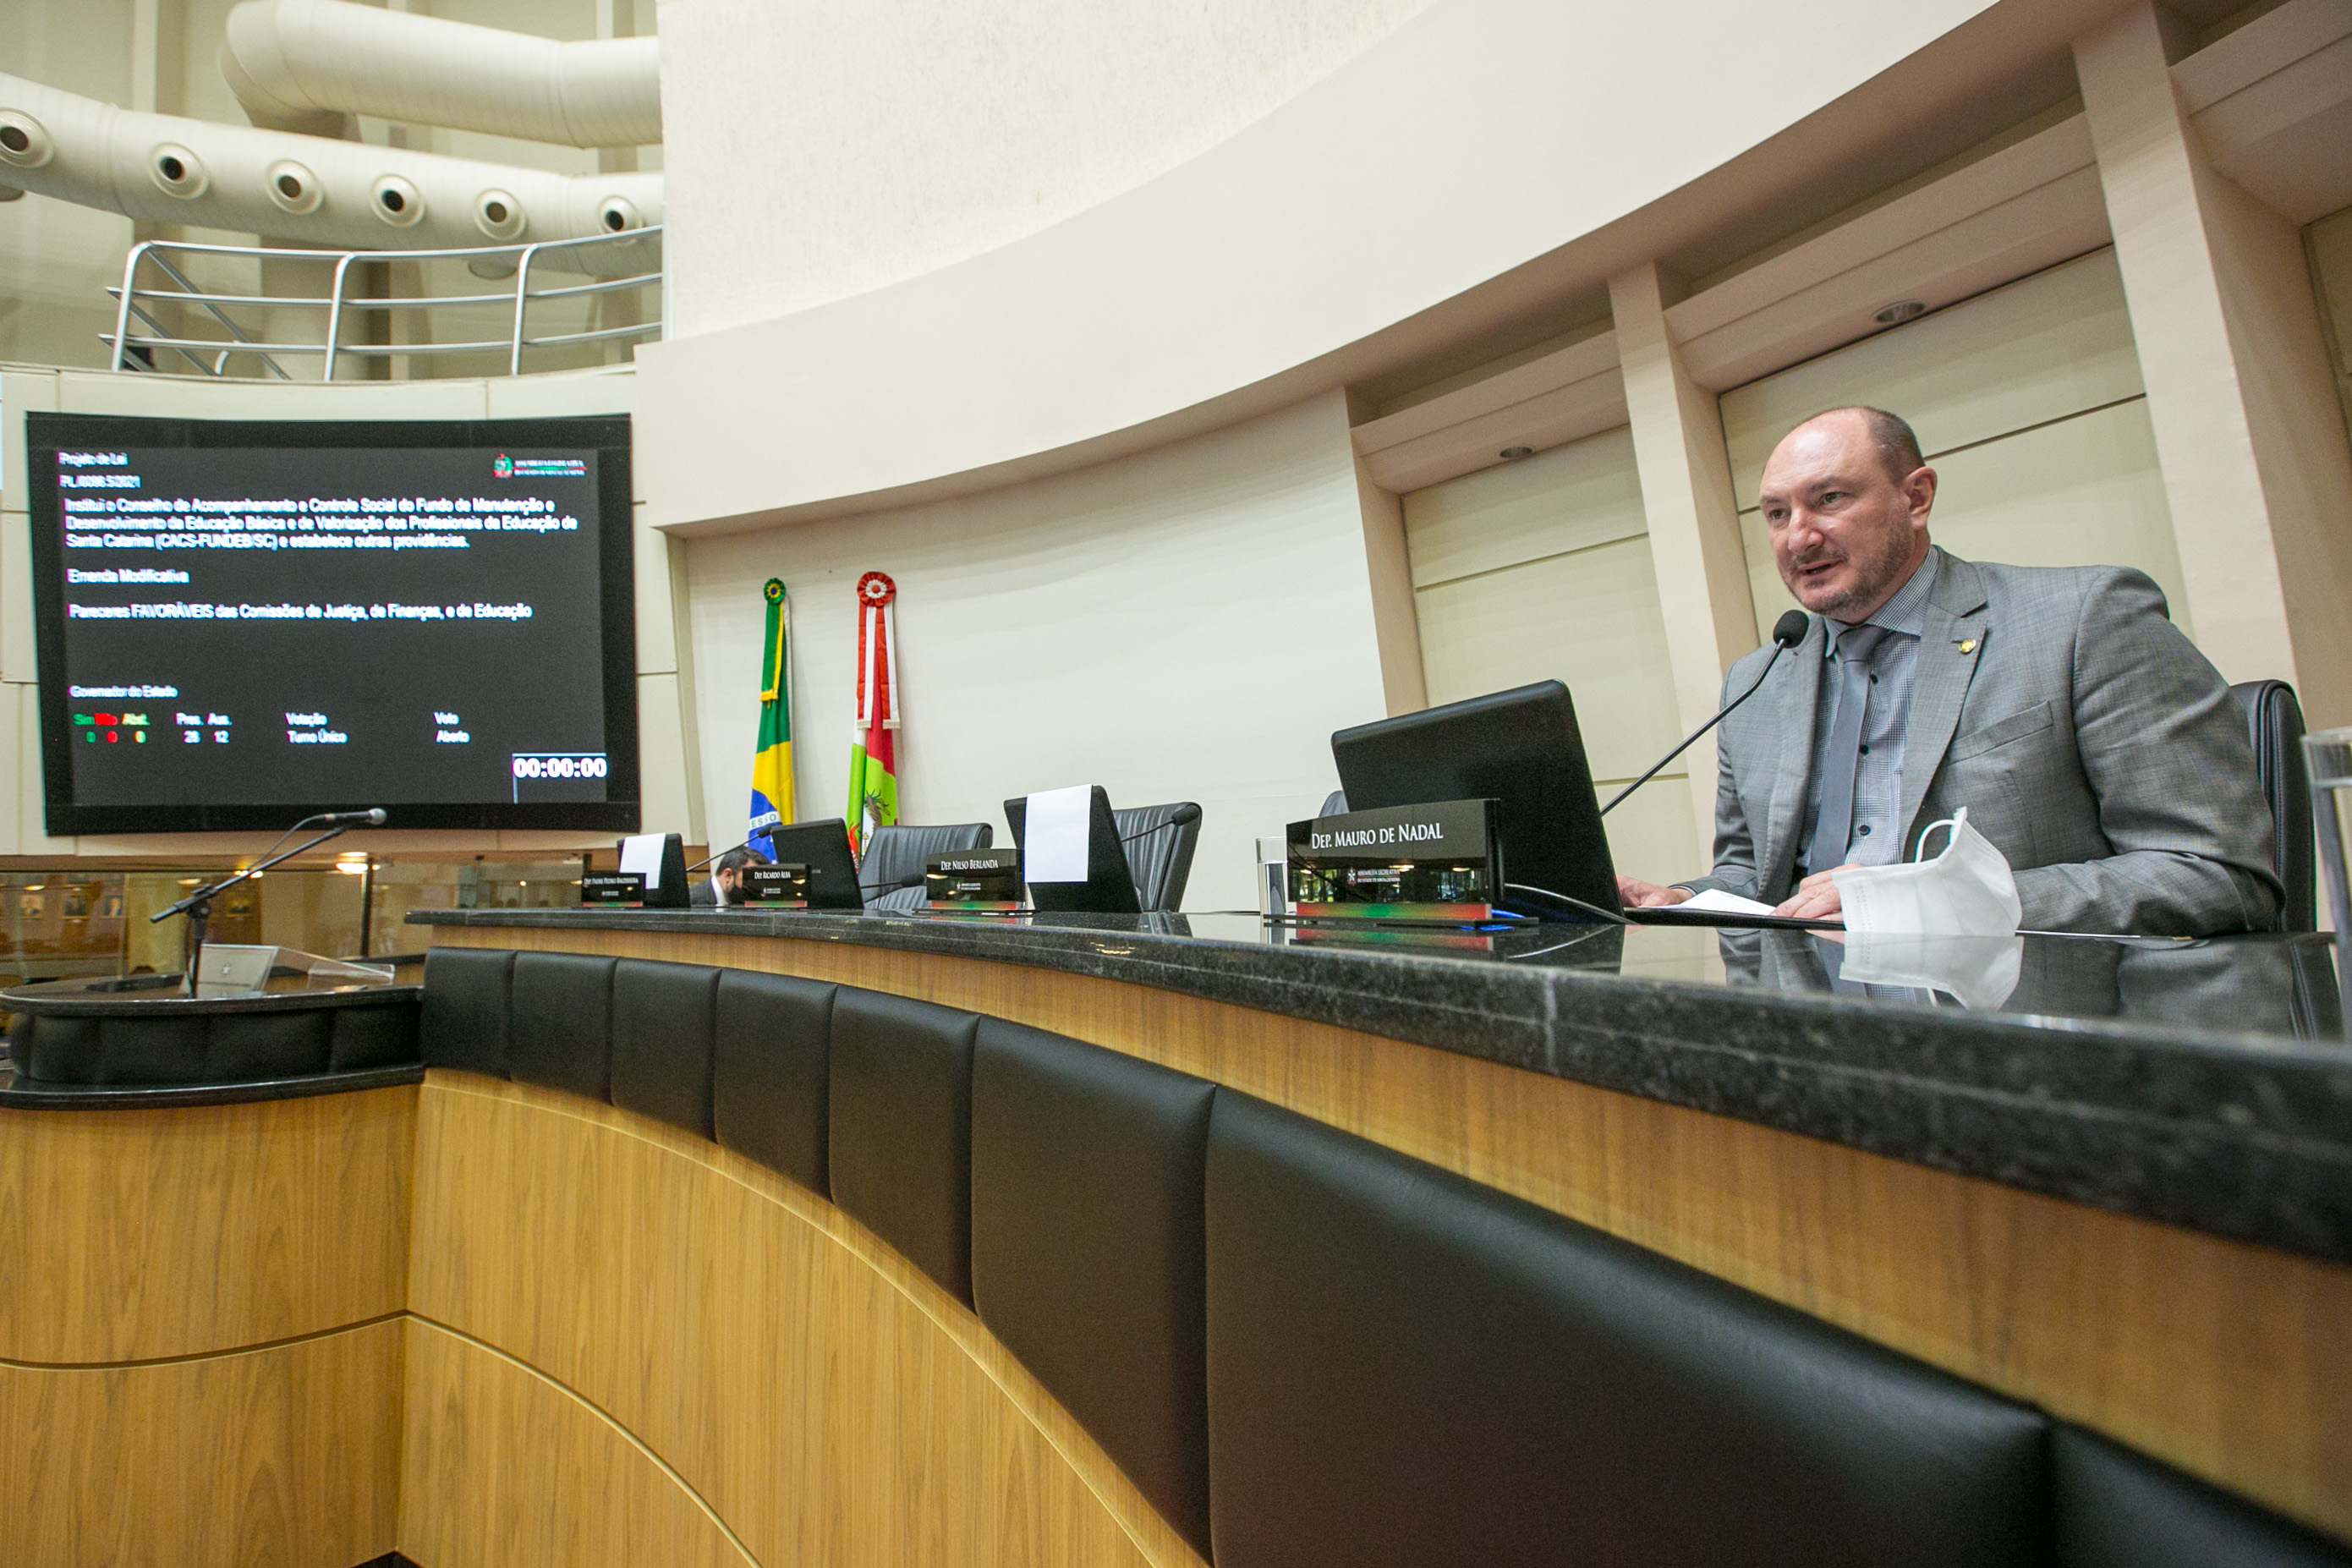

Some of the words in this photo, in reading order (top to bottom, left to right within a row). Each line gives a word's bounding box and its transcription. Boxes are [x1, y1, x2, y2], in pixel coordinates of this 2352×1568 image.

[110, 452, 129, 465] Lei
[63, 498, 105, 512] Institui
[106, 502, 116, 512] o
[116, 498, 173, 512] Conselho
[173, 498, 190, 512] de
[191, 498, 297, 514] Acompanhamento
[298, 502, 308, 512] e
[308, 498, 359, 513] Controle
[359, 498, 397, 513] Social
[397, 499, 414, 513] do
[415, 498, 453, 513] Fundo
[454, 498, 471, 513] de
[472, 497, 544, 515] Manutenção
[545, 502, 556, 513] e
[64, 516, 167, 530] Desenvolvimento
[167, 516, 184, 530] da
[185, 515, 244, 533] Educação
[244, 515, 286, 530] Básica
[287, 519, 297, 530] e
[298, 516, 315, 530] de
[315, 515, 384, 533] Valorização
[384, 516, 407, 530] dos
[408, 516, 482, 530] Profissionais
[484, 516, 501, 530] da
[502, 515, 560, 533] Educação
[561, 515, 578, 530] de
[65, 534, 103, 548] Santa
[103, 534, 154, 548] Catarina
[278, 537, 288, 548] e
[289, 534, 353, 548] estabelece
[354, 535, 392, 548] outras
[392, 533, 470, 551] providências.
[66, 569, 118, 583] Emenda
[118, 568, 189, 584] Modificativa
[68, 604, 130, 619] Pareceres
[130, 601, 213, 619] FAVORÁVEIS
[214, 604, 238, 619] das
[238, 603, 304, 619] Comissões
[305, 604, 322, 618] de
[323, 603, 369, 622] Justiça,
[370, 604, 387, 618] de
[387, 603, 445, 622] Finanças,
[445, 606, 456, 618] e
[456, 604, 473, 618] de
[474, 602, 533, 622] Educação
[69, 686, 127, 698] Governador
[127, 686, 142, 698] do
[142, 686, 178, 698] Estado
[73, 713, 94, 726] Sim
[284, 712, 328, 727] Votação
[433, 711, 459, 726] Voto
[213, 731, 230, 743] 12
[287, 731, 318, 743] Turno
[318, 728, 348, 743] Único
[436, 730, 470, 743] Aberto
[513, 757, 607, 779] 00:00:00
